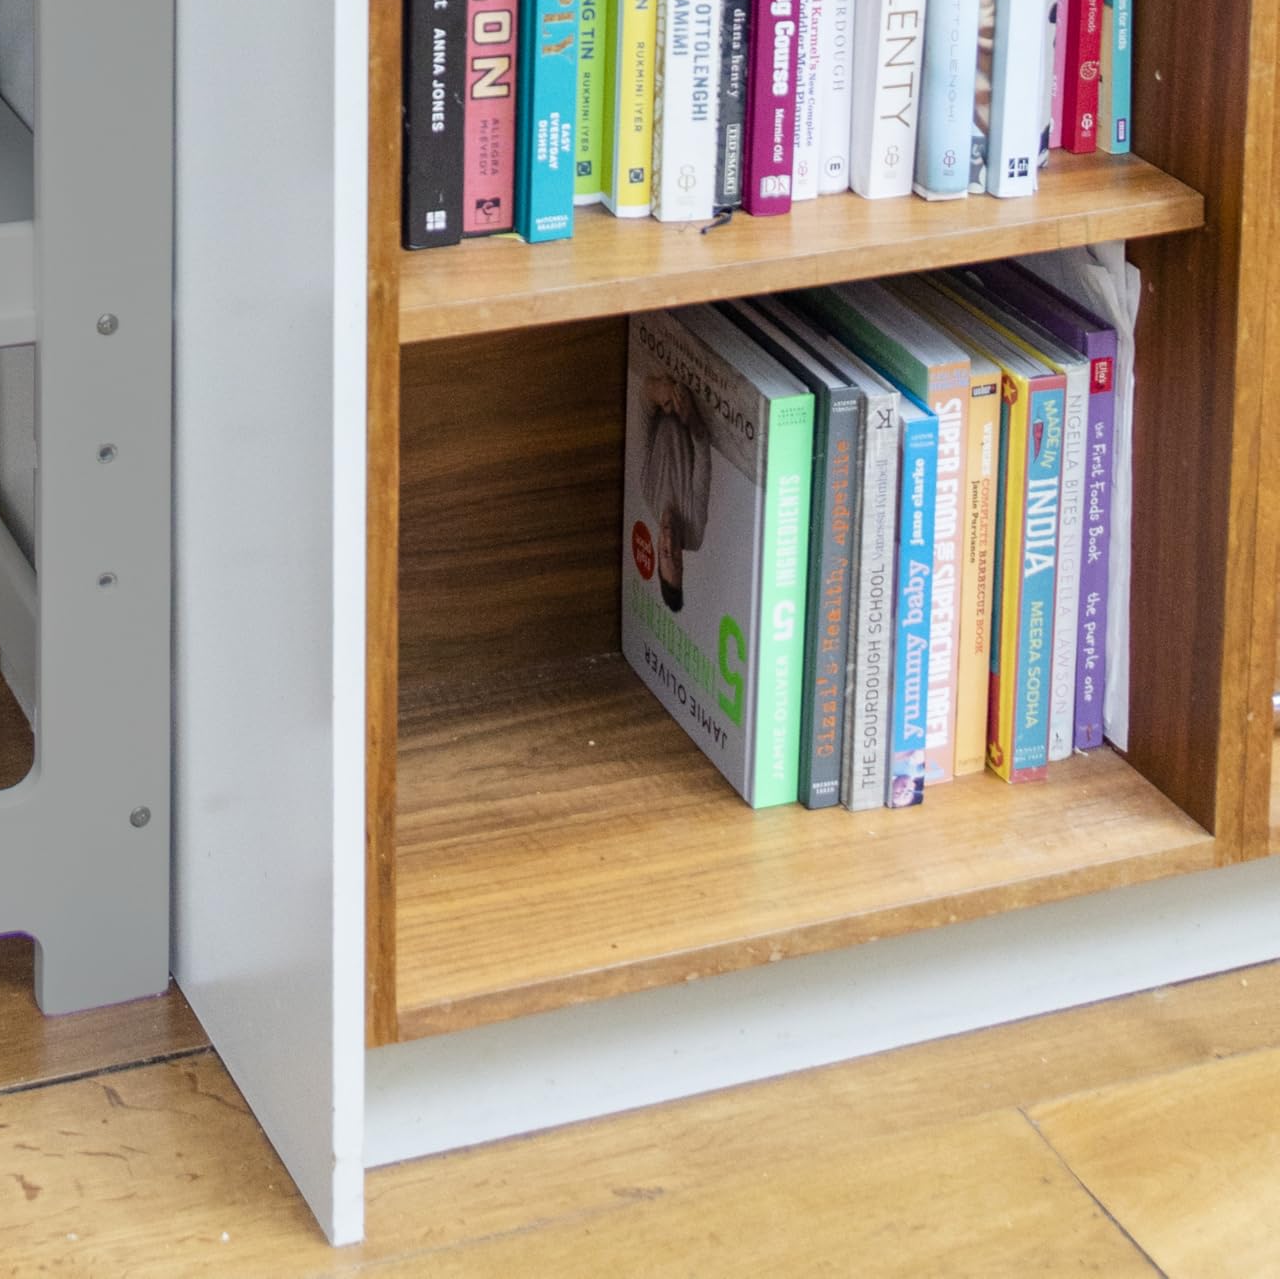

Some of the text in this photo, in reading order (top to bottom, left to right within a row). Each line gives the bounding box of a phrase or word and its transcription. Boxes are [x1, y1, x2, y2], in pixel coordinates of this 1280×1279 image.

[580, 27, 595, 60] TIN
[732, 8, 746, 50] diana
[809, 7, 822, 70] Karmel's
[1087, 9, 1096, 33] Foods
[1118, 11, 1128, 27] for
[1118, 28, 1128, 50] kids
[431, 28, 447, 134] ANNA JONES
[634, 41, 645, 98] RUKMINI
[691, 8, 712, 122] OTTOLENGHI
[727, 53, 745, 99] henry
[772, 20, 795, 96] Course
[796, 53, 807, 87] Meal
[807, 73, 816, 96] New
[581, 72, 591, 122] RUKMINI
[633, 102, 643, 133] IYER
[793, 90, 805, 149] Planner
[806, 97, 816, 147] Complete
[490, 117, 501, 176] ALLEGRA
[537, 120, 548, 162] DISHES
[549, 112, 561, 170] EVERYDAY
[560, 122, 571, 153] EASY
[580, 125, 590, 152] IYER
[773, 108, 784, 163] Marnie Old
[726, 152, 736, 190] SMART
[763, 176, 790, 192] DK
[638, 325, 672, 365] FOOD
[673, 359, 701, 395] EASY
[712, 394, 755, 441] QUICK
[936, 397, 962, 474] SUPER
[1040, 399, 1061, 469] MADE IN
[911, 458, 925, 507] clarke
[1091, 443, 1107, 479] First
[831, 439, 850, 546] Appetite
[933, 478, 958, 543] FOOD
[978, 477, 991, 548] COMPLETE
[1089, 481, 1105, 521] Foods
[775, 474, 801, 588] INGREDIENTS
[910, 511, 925, 546] jane
[969, 480, 981, 564] Jamie Purviance
[1023, 475, 1059, 578] INDIA
[1087, 526, 1104, 564] Book
[976, 549, 987, 615] BARBECUE
[1055, 395, 1082, 715] NIGELLA BITES NIGELLA LAWSON
[772, 600, 797, 641] 5
[821, 557, 848, 652] Healthy
[902, 560, 930, 629] baby
[861, 459, 889, 788] THE SOURDOUGH SCHOOL Vanessa Kimbell
[975, 619, 985, 654] BOOK
[1028, 601, 1044, 663] MEERA
[1083, 592, 1101, 702] the purple one
[642, 641, 729, 749] JAMIE OLIVER
[718, 613, 746, 727] 5
[903, 633, 929, 741] yummy
[1024, 665, 1041, 729] SODHA
[772, 655, 790, 780] JAMIE OLIVER
[816, 662, 839, 758] Gizzi's
